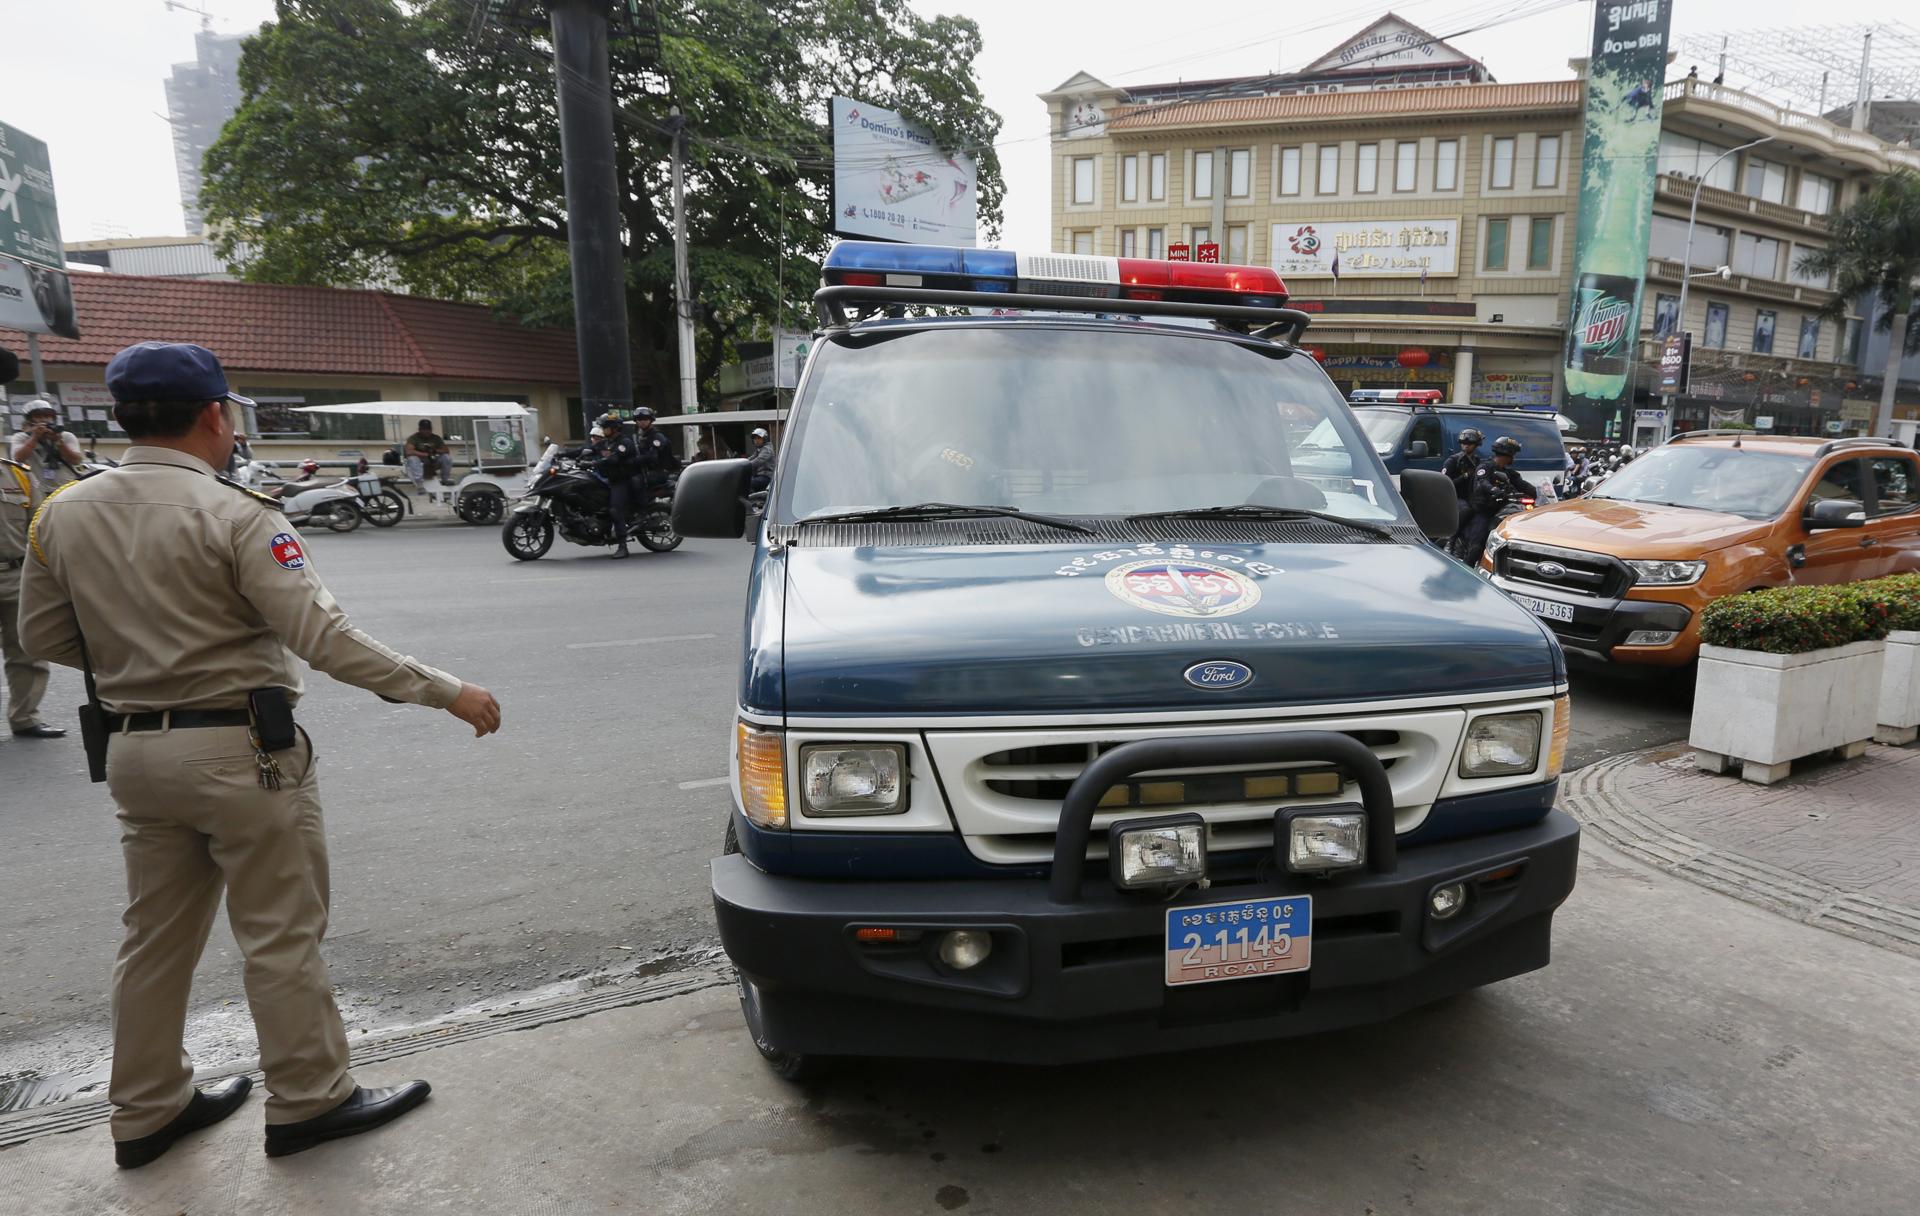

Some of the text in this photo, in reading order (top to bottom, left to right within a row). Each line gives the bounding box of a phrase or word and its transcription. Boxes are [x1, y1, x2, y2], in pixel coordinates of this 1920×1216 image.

[1639, 33, 1662, 48] DEW
[861, 118, 905, 138] Domino's
[907, 130, 931, 145] Pizza
[1170, 250, 1188, 258] MINI
[1392, 256, 1431, 268] Mall
[1324, 356, 1358, 367] Happy
[1360, 357, 1385, 367] New
[1201, 666, 1236, 682] Ford
[1182, 923, 1293, 966] 2-1145
[1204, 960, 1275, 977] RCAF
